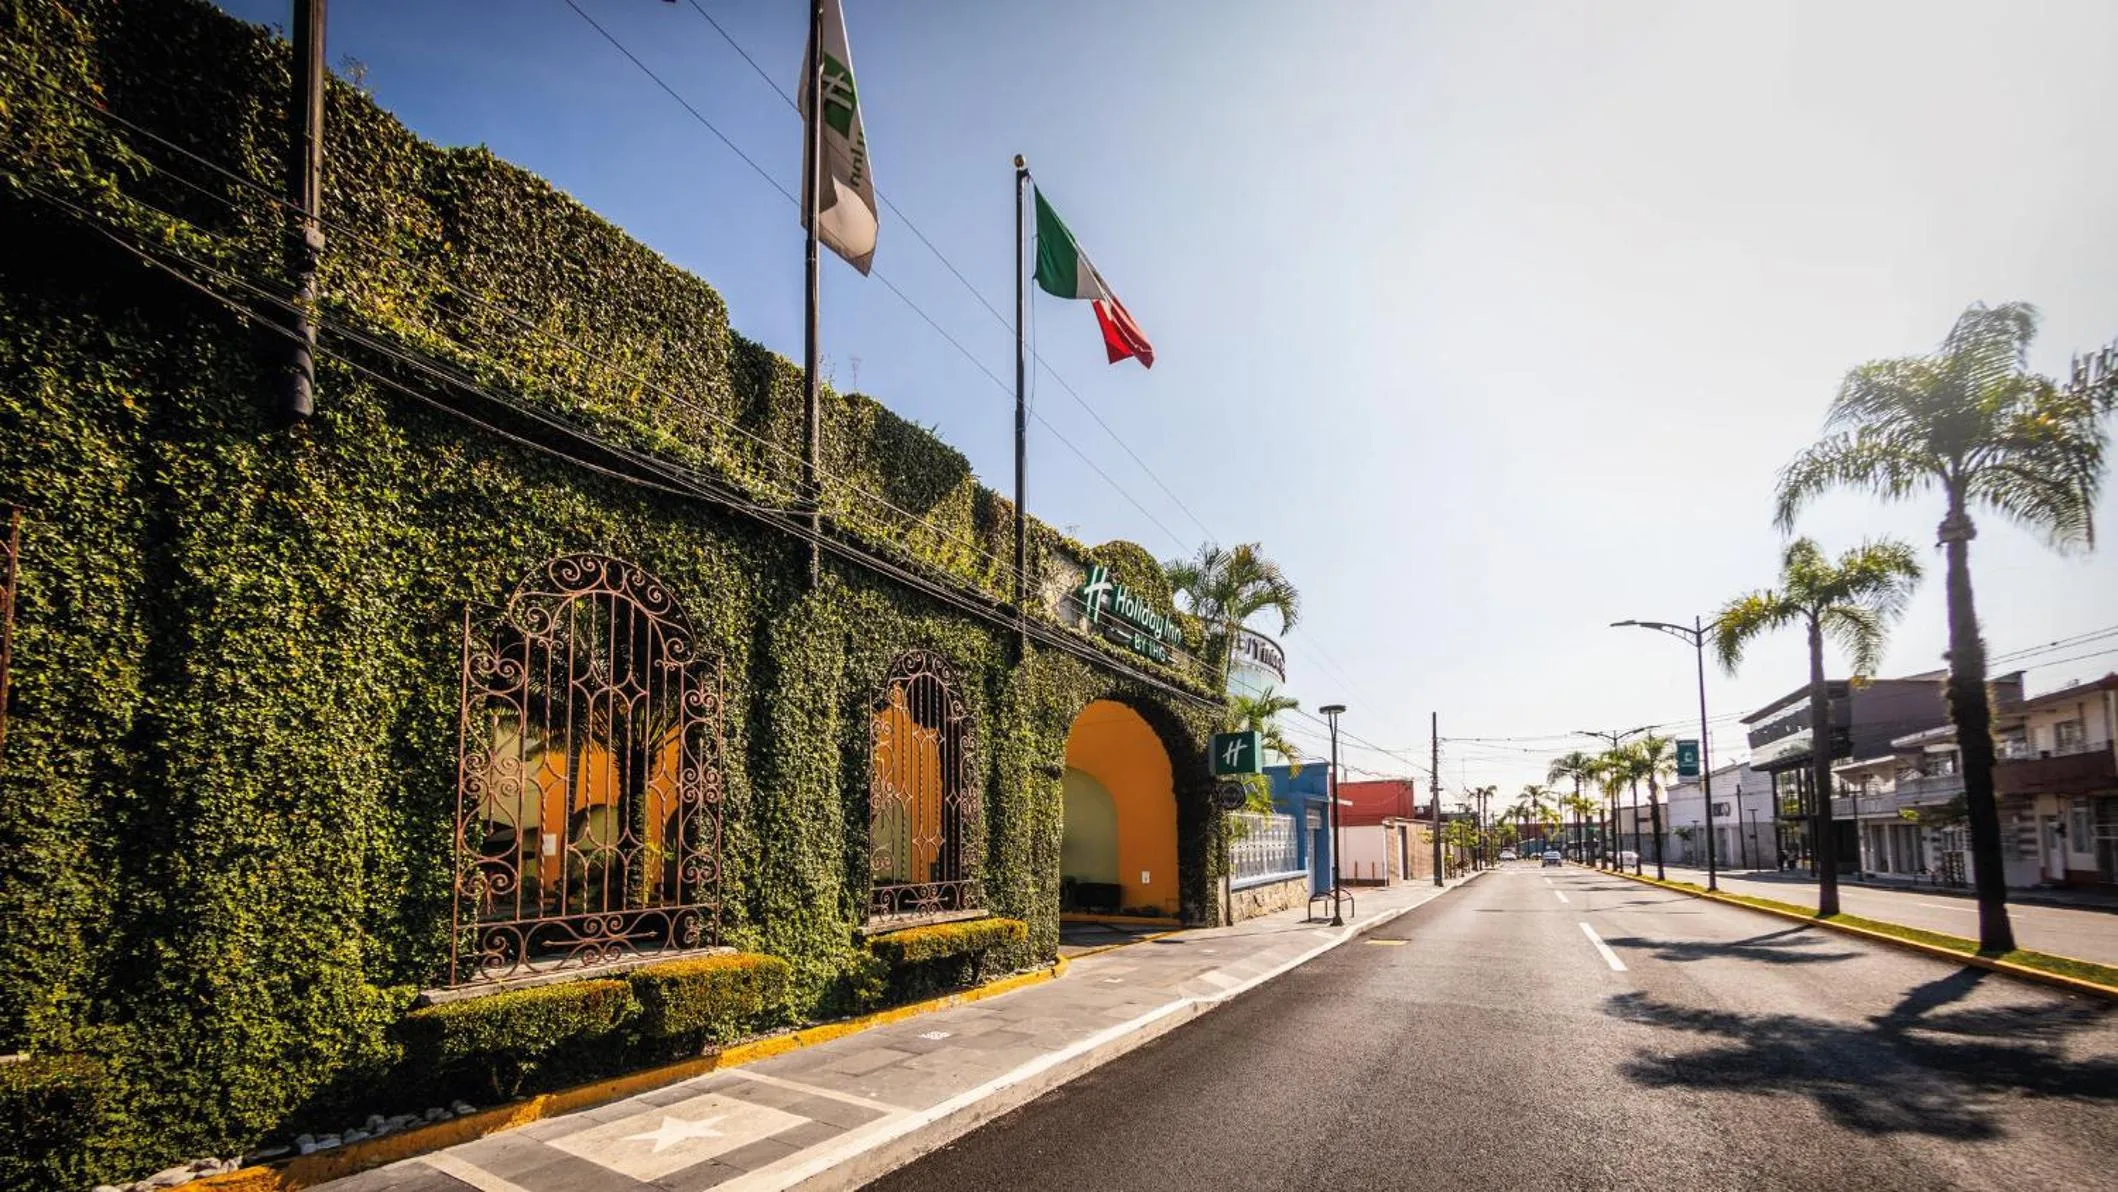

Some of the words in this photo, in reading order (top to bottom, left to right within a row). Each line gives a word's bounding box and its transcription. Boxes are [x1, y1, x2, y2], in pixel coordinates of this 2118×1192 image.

[1115, 584, 1164, 640] Holiday
[1164, 613, 1182, 644] Inn
[1134, 633, 1148, 653] BY
[1148, 640, 1167, 662] IHG
